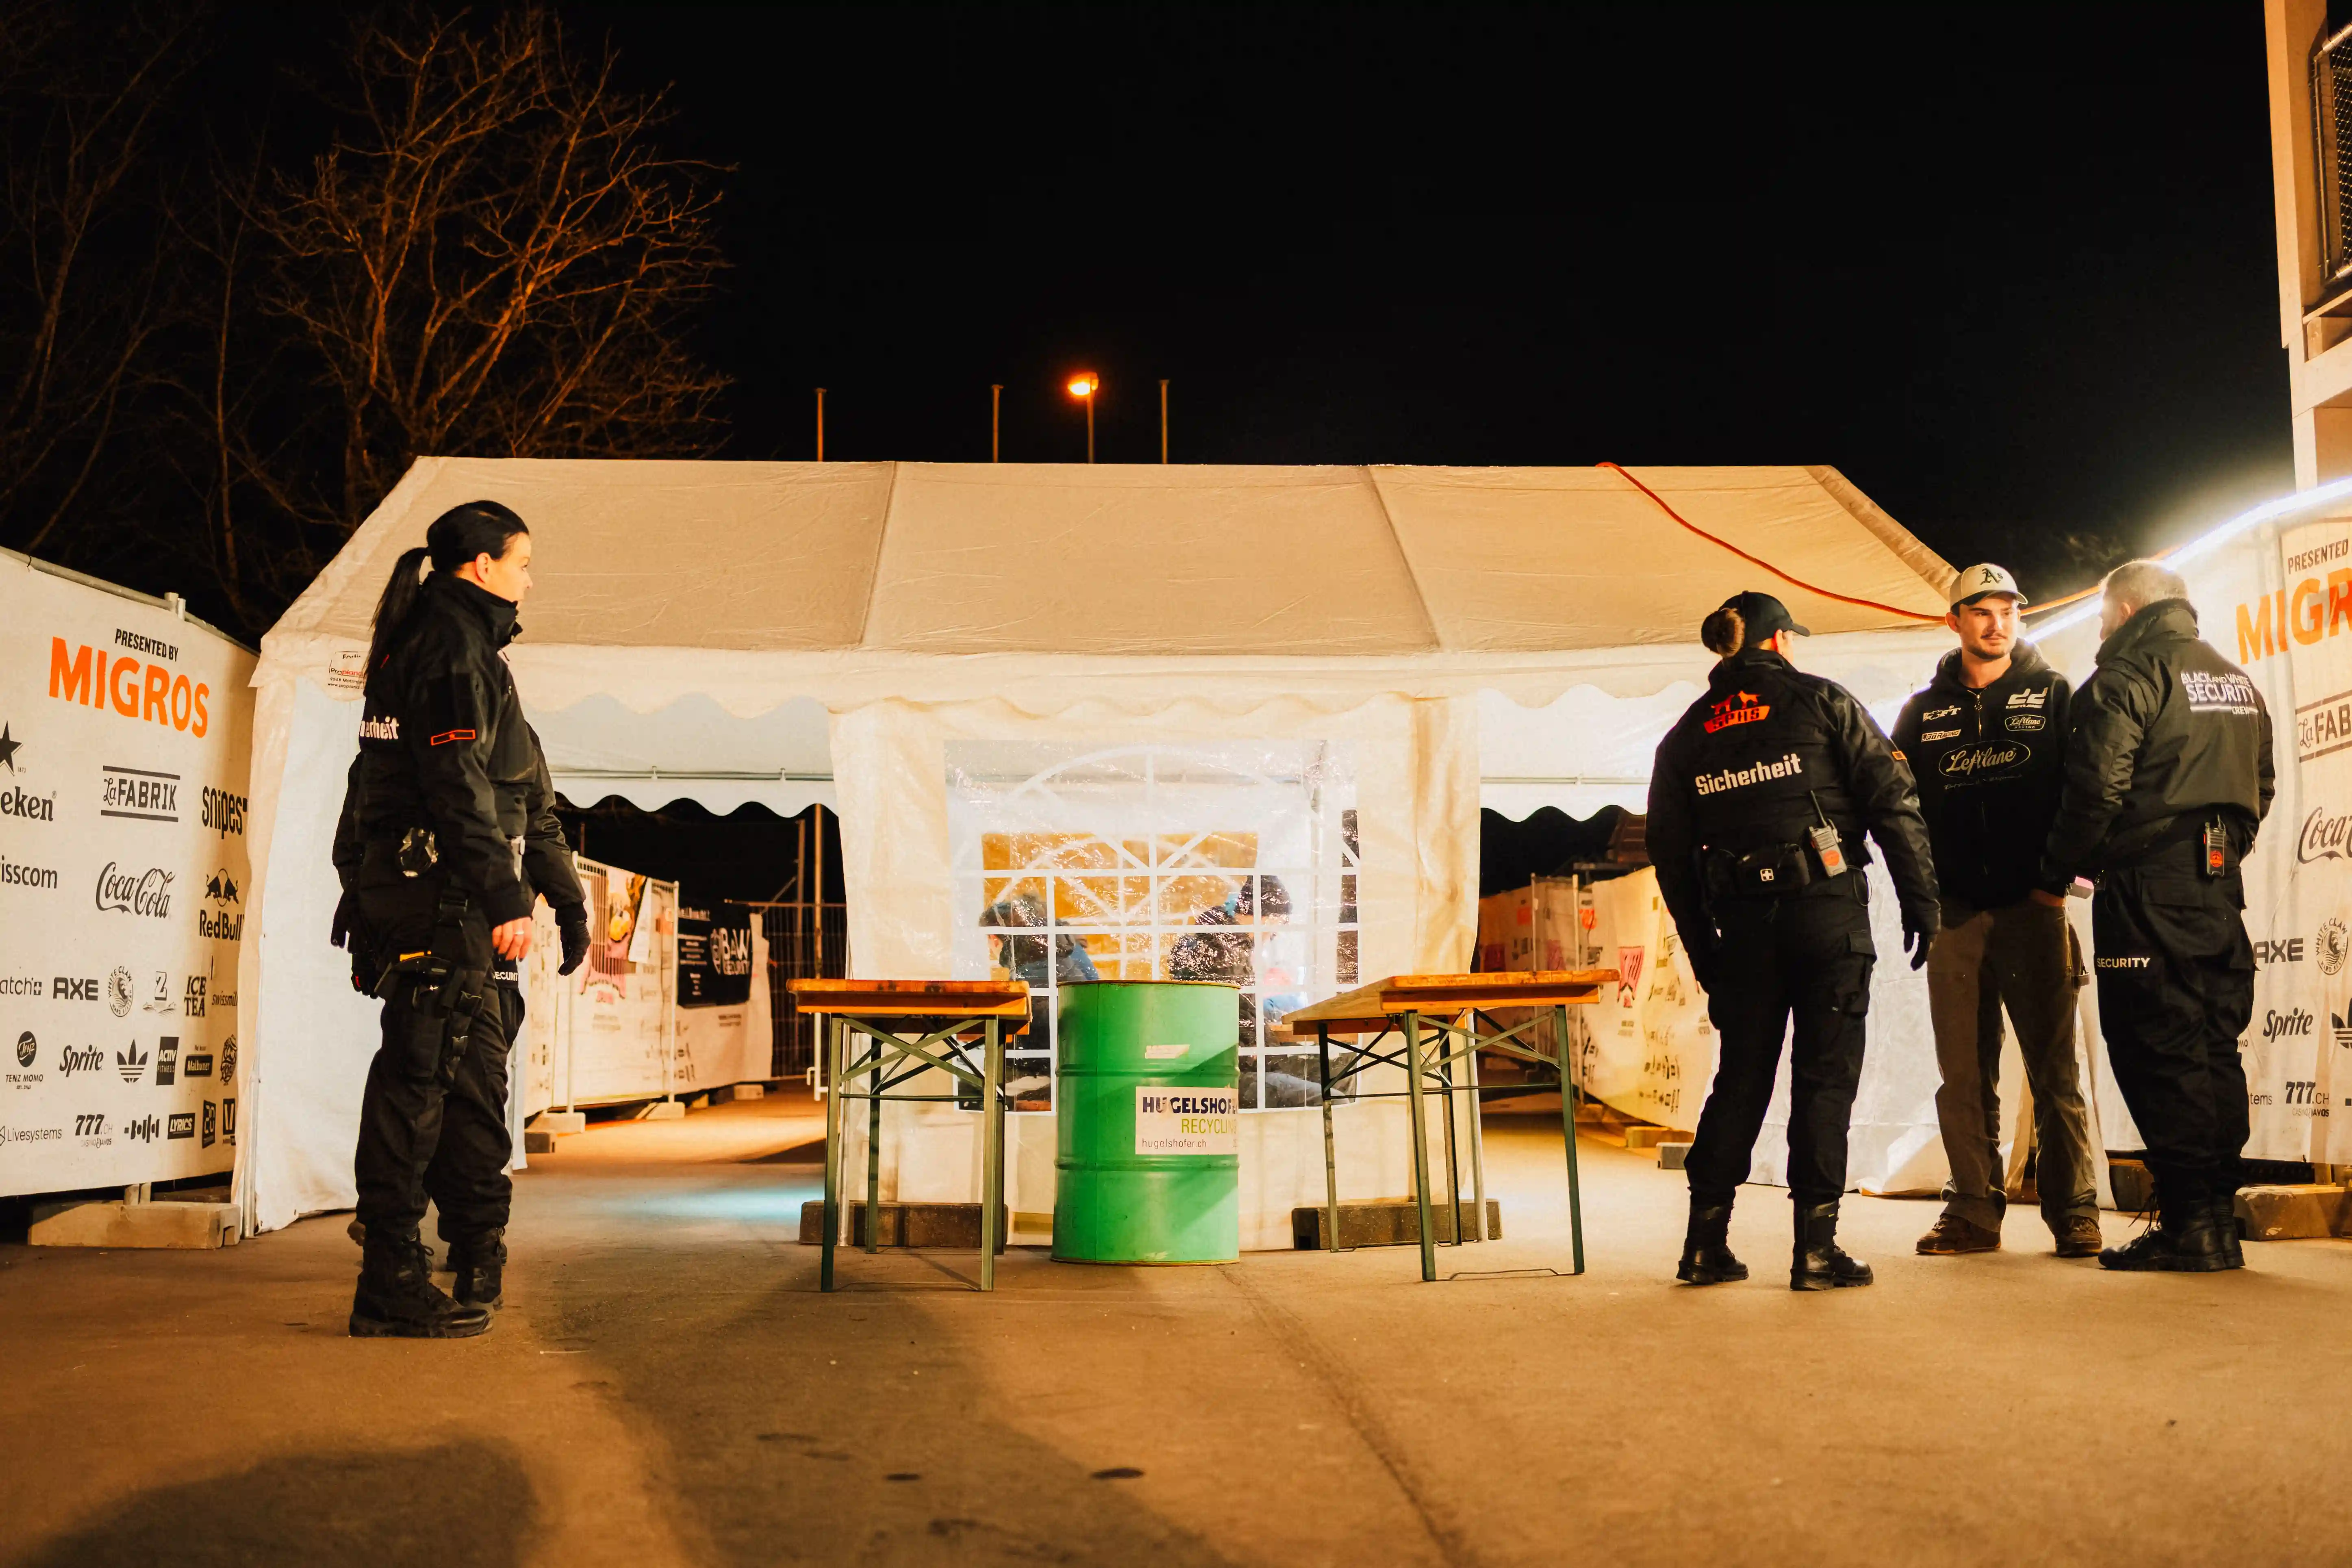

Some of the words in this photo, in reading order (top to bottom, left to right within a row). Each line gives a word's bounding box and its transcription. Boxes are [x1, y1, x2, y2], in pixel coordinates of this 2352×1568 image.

[2288, 538, 2349, 575] PRESENTED
[2236, 567, 2352, 665] MIGR
[115, 628, 167, 658] PRESENTED
[169, 643, 179, 662] BY
[49, 636, 209, 738] MIGROS
[2180, 671, 2212, 684] BLACK
[2185, 684, 2255, 704] SECURITY
[2315, 704, 2352, 745] FAB
[1695, 753, 1802, 795] Sicherheit
[0, 786, 53, 821] eken
[202, 785, 243, 840] snipes
[0, 855, 57, 889] isscom
[2096, 957, 2150, 968] SECURITY
[2253, 938, 2304, 964] AXE
[0, 976, 33, 995] atch
[493, 971, 518, 982] ECURIT
[53, 977, 98, 1001] AXE
[184, 996, 205, 1017] TEA
[2263, 1008, 2313, 1043] Sprite
[59, 1045, 104, 1077] Sprite
[158, 1049, 177, 1062] ACTIV
[6, 1074, 21, 1083] TENZ
[23, 1074, 43, 1082] MOMO
[157, 1065, 175, 1073] FITNESS
[2285, 1081, 2330, 1104] 777.CH
[7, 1128, 62, 1143] Livesystems
[75, 1114, 113, 1136] 777.CH
[170, 1118, 193, 1132] LYRICS
[1142, 1138, 1206, 1150] hugelshofer.ch
